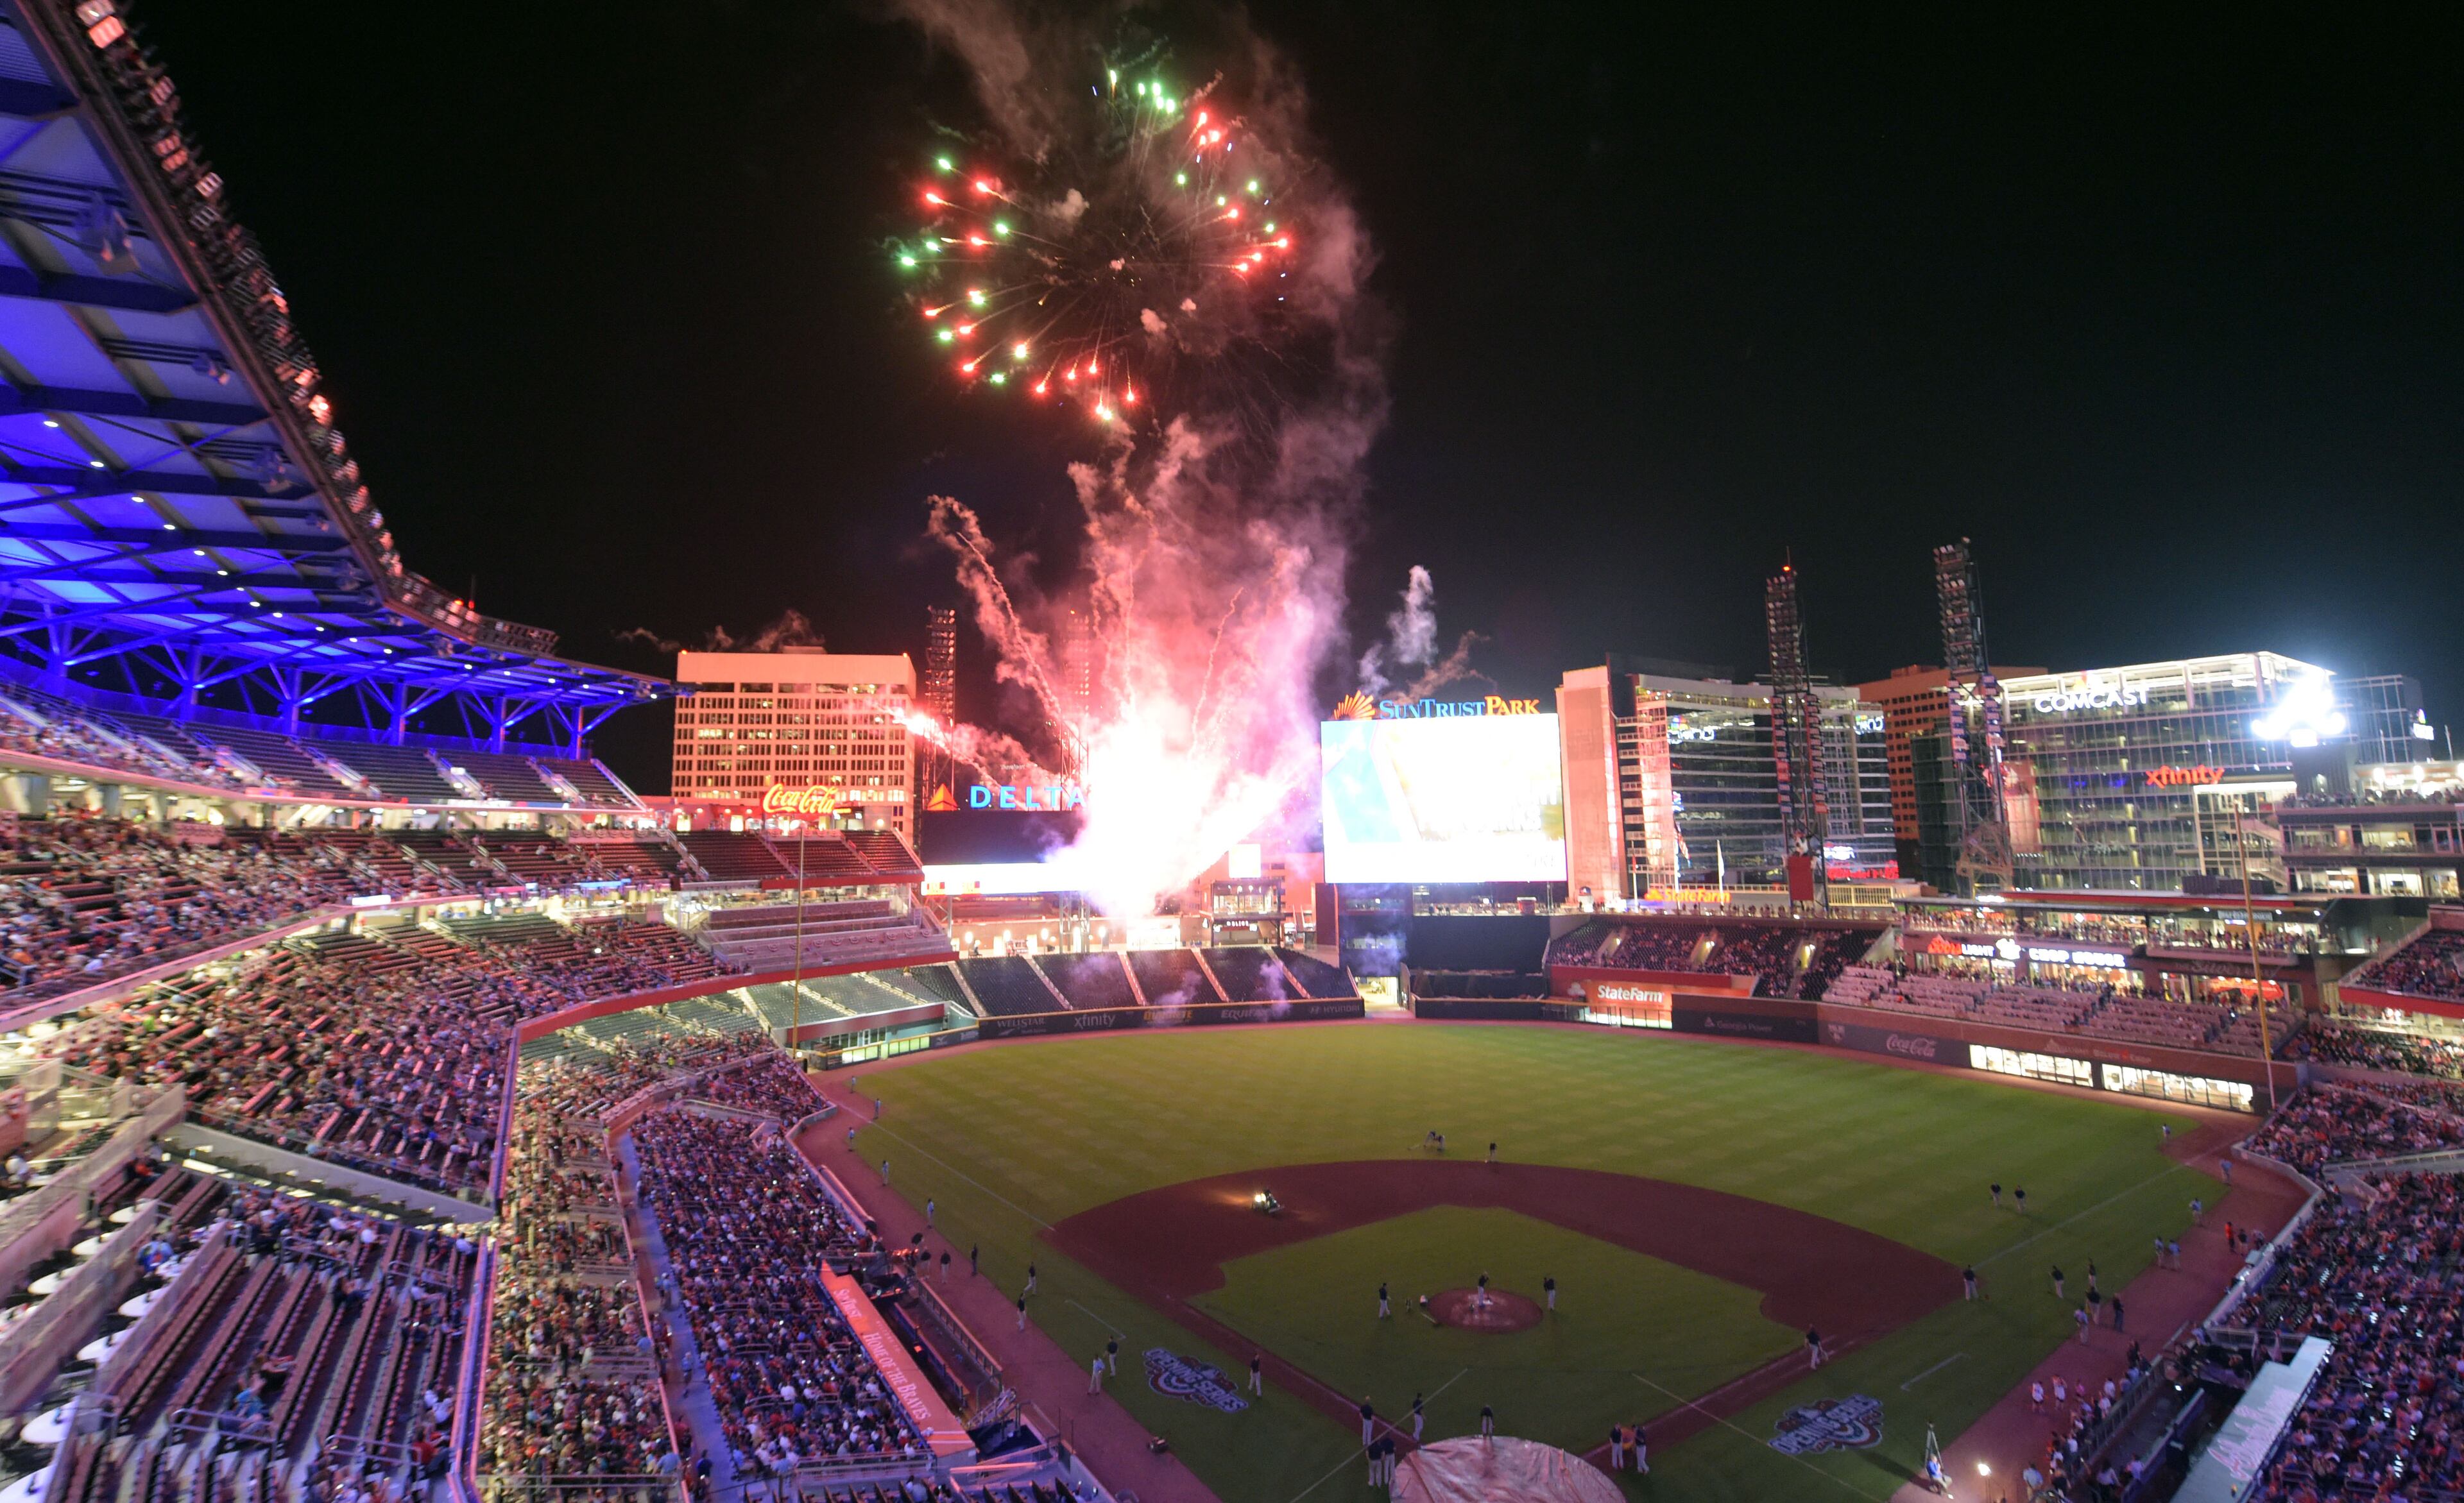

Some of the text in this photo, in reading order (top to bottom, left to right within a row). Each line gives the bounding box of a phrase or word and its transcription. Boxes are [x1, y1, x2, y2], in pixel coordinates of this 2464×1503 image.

[2035, 684, 2149, 713] COMCAST
[2145, 764, 2225, 789] xfinity
[763, 783, 838, 814] Coca-Cola
[970, 785, 1087, 808] DELTA
[1074, 1013, 1116, 1030] xfinity
[1322, 1005, 1360, 1014] HYUNDAI
[898, 1382, 932, 1420] BRAVES
